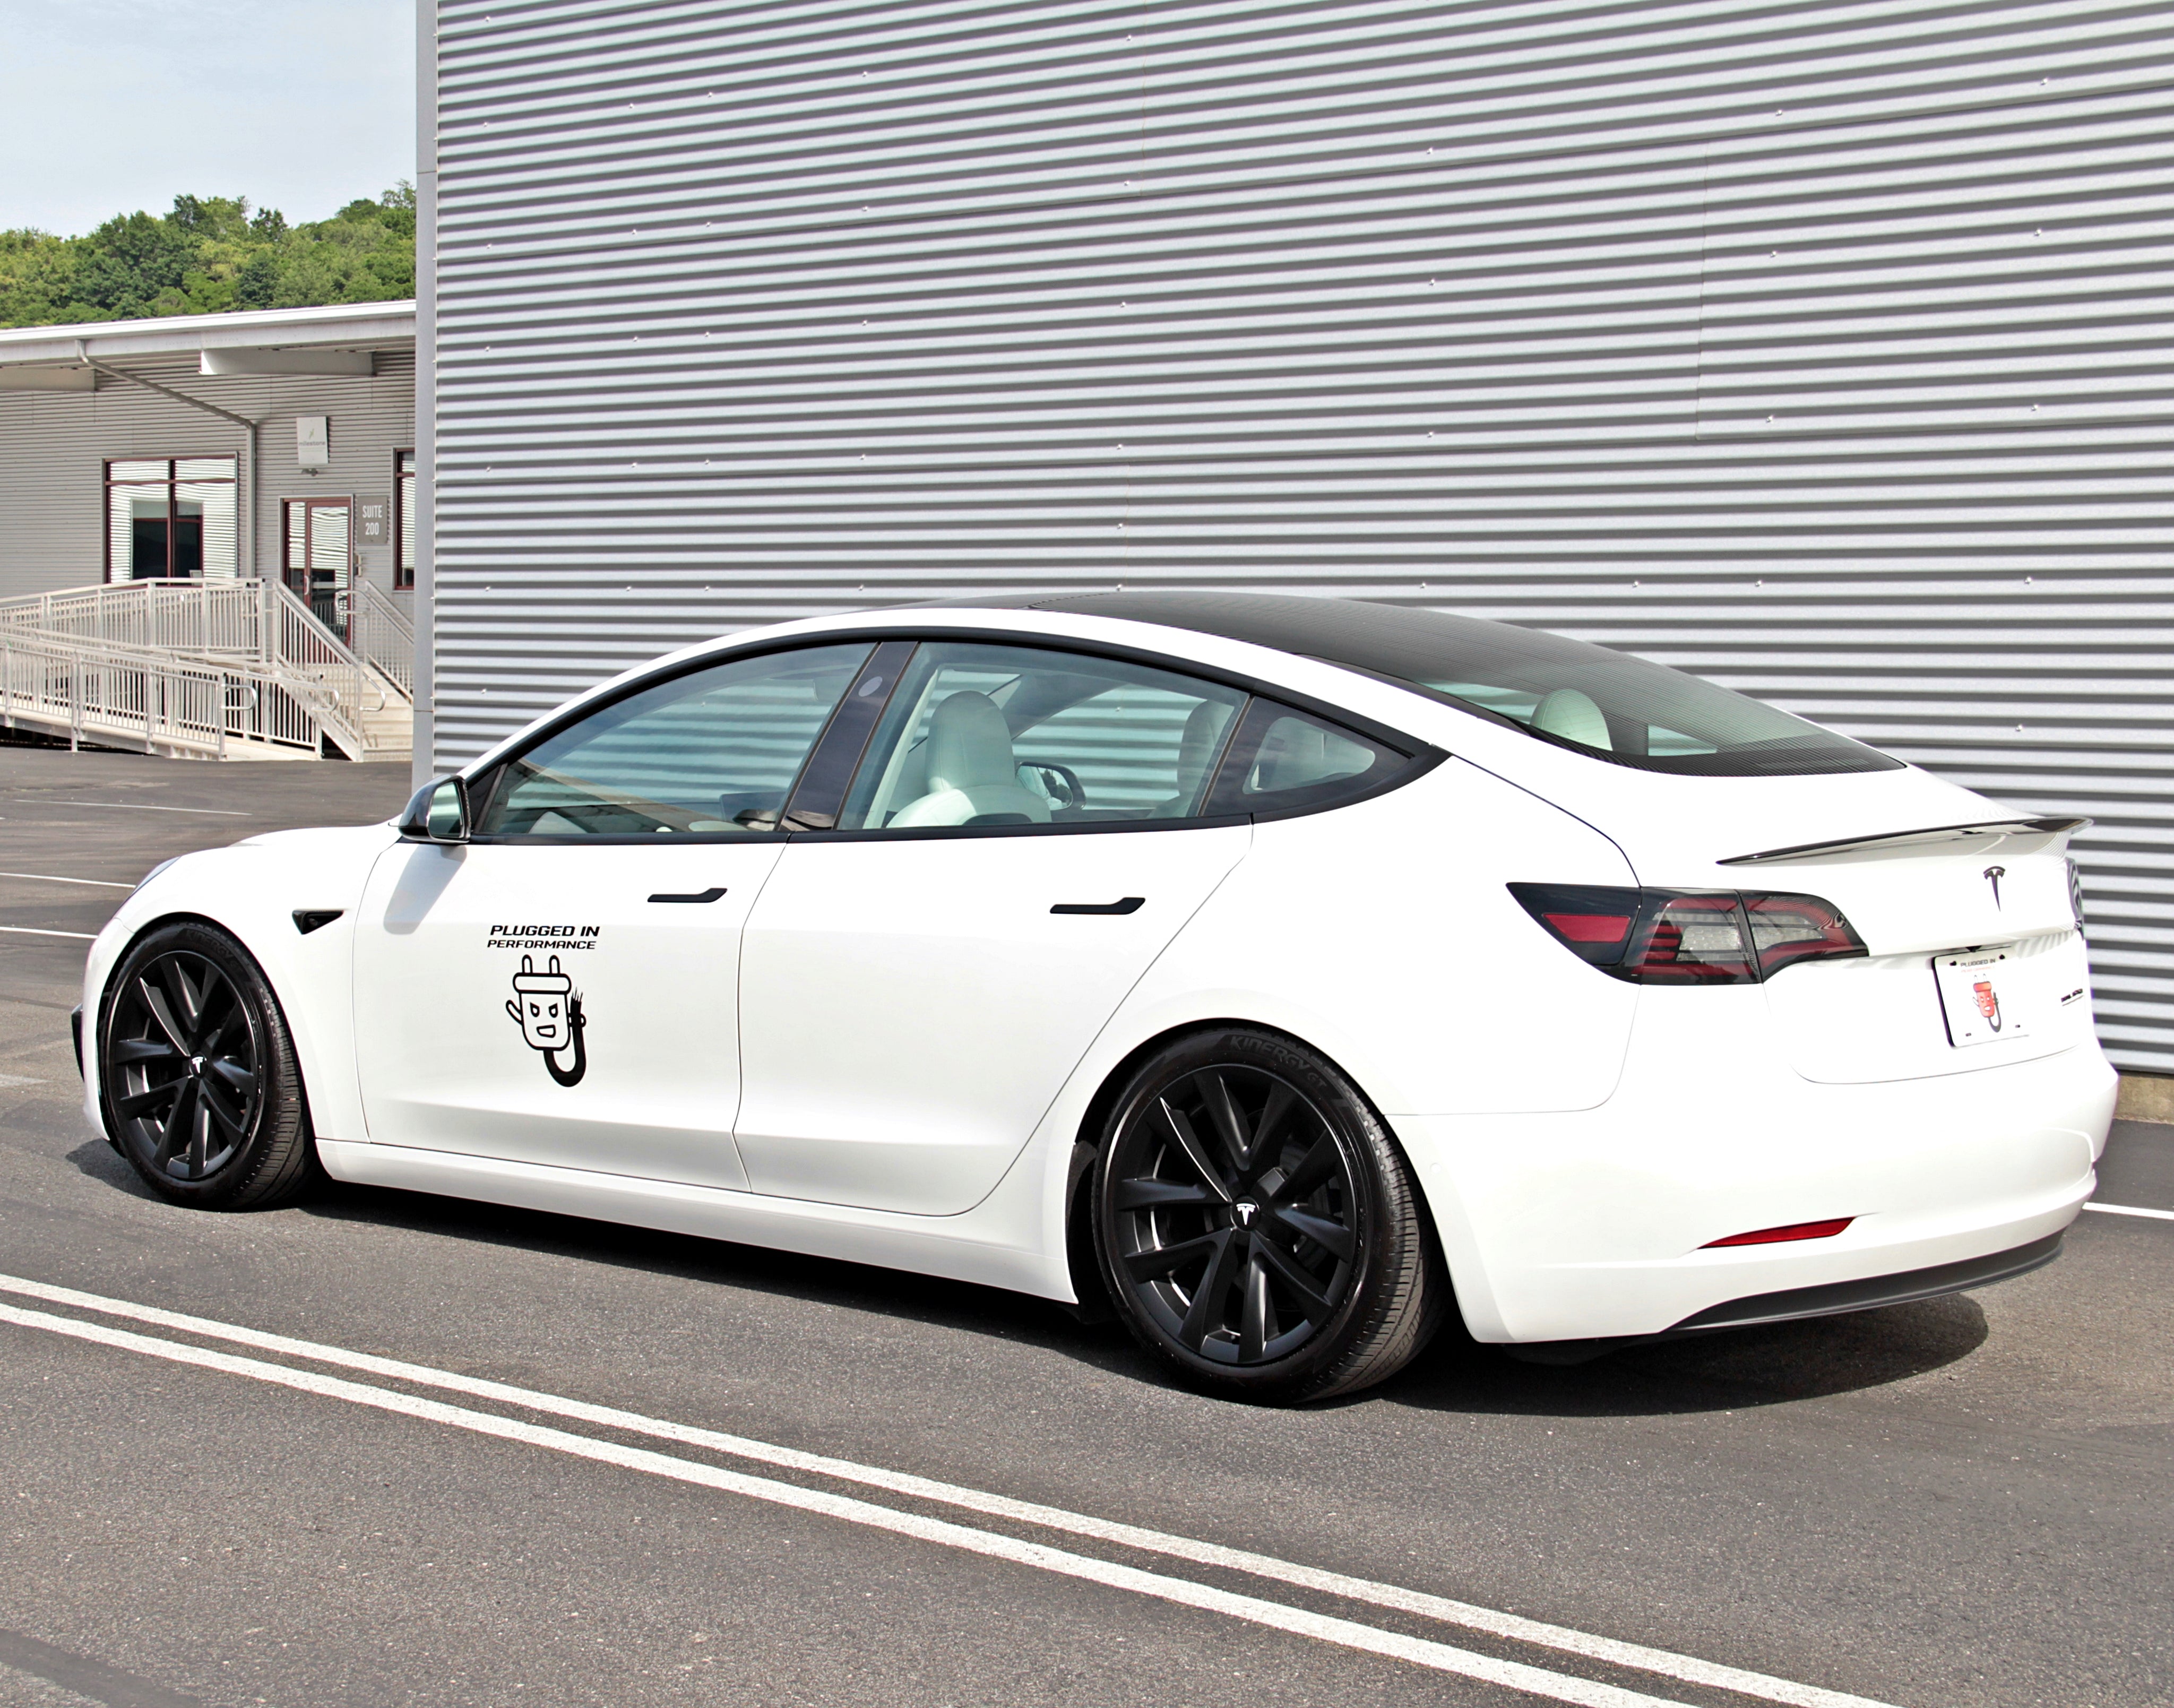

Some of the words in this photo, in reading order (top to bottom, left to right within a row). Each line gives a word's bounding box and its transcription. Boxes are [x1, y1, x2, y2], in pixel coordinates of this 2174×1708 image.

[362, 505, 383, 519] SUITE
[365, 522, 379, 536] 200
[490, 925, 575, 936] PLUGGED
[580, 926, 600, 937] IN
[487, 939, 597, 950] PERFORMANCE
[1229, 1035, 1310, 1069] KINERGY
[1307, 1072, 1327, 1088] GT
